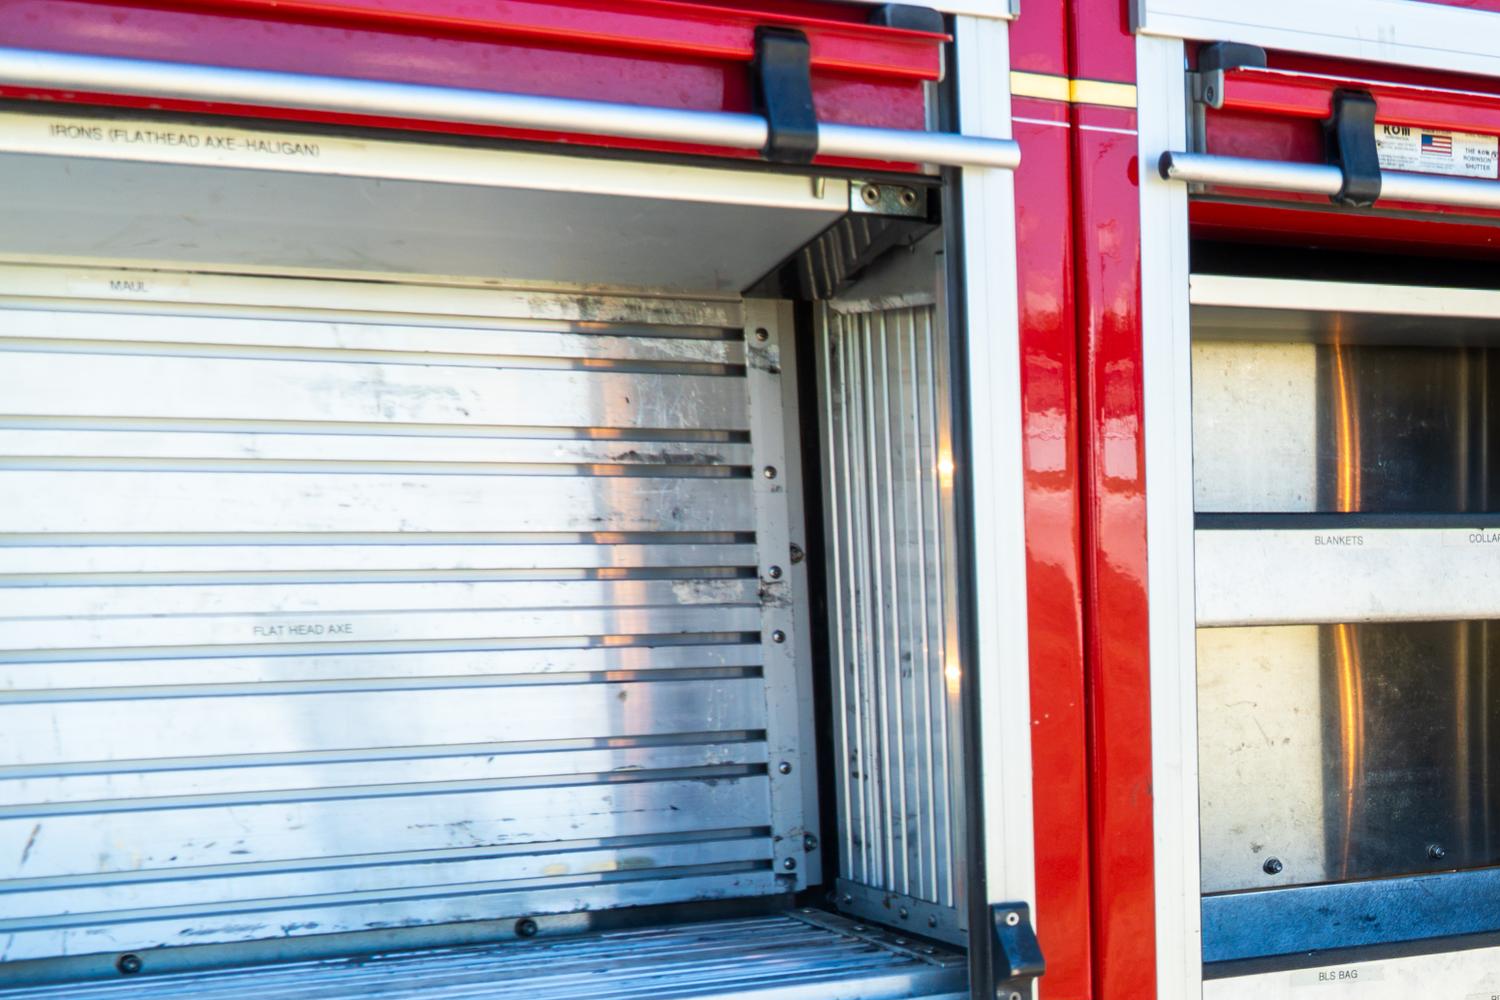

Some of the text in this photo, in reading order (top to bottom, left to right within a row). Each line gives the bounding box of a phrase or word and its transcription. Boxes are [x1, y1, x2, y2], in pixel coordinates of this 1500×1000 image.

[50, 124, 104, 140] IRONS
[108, 128, 201, 147] (FLATHEAD
[1314, 535, 1364, 546] BLANKETS
[253, 623, 353, 637] FLAT HEAD AXE
[1318, 969, 1358, 981] BLS BAG
